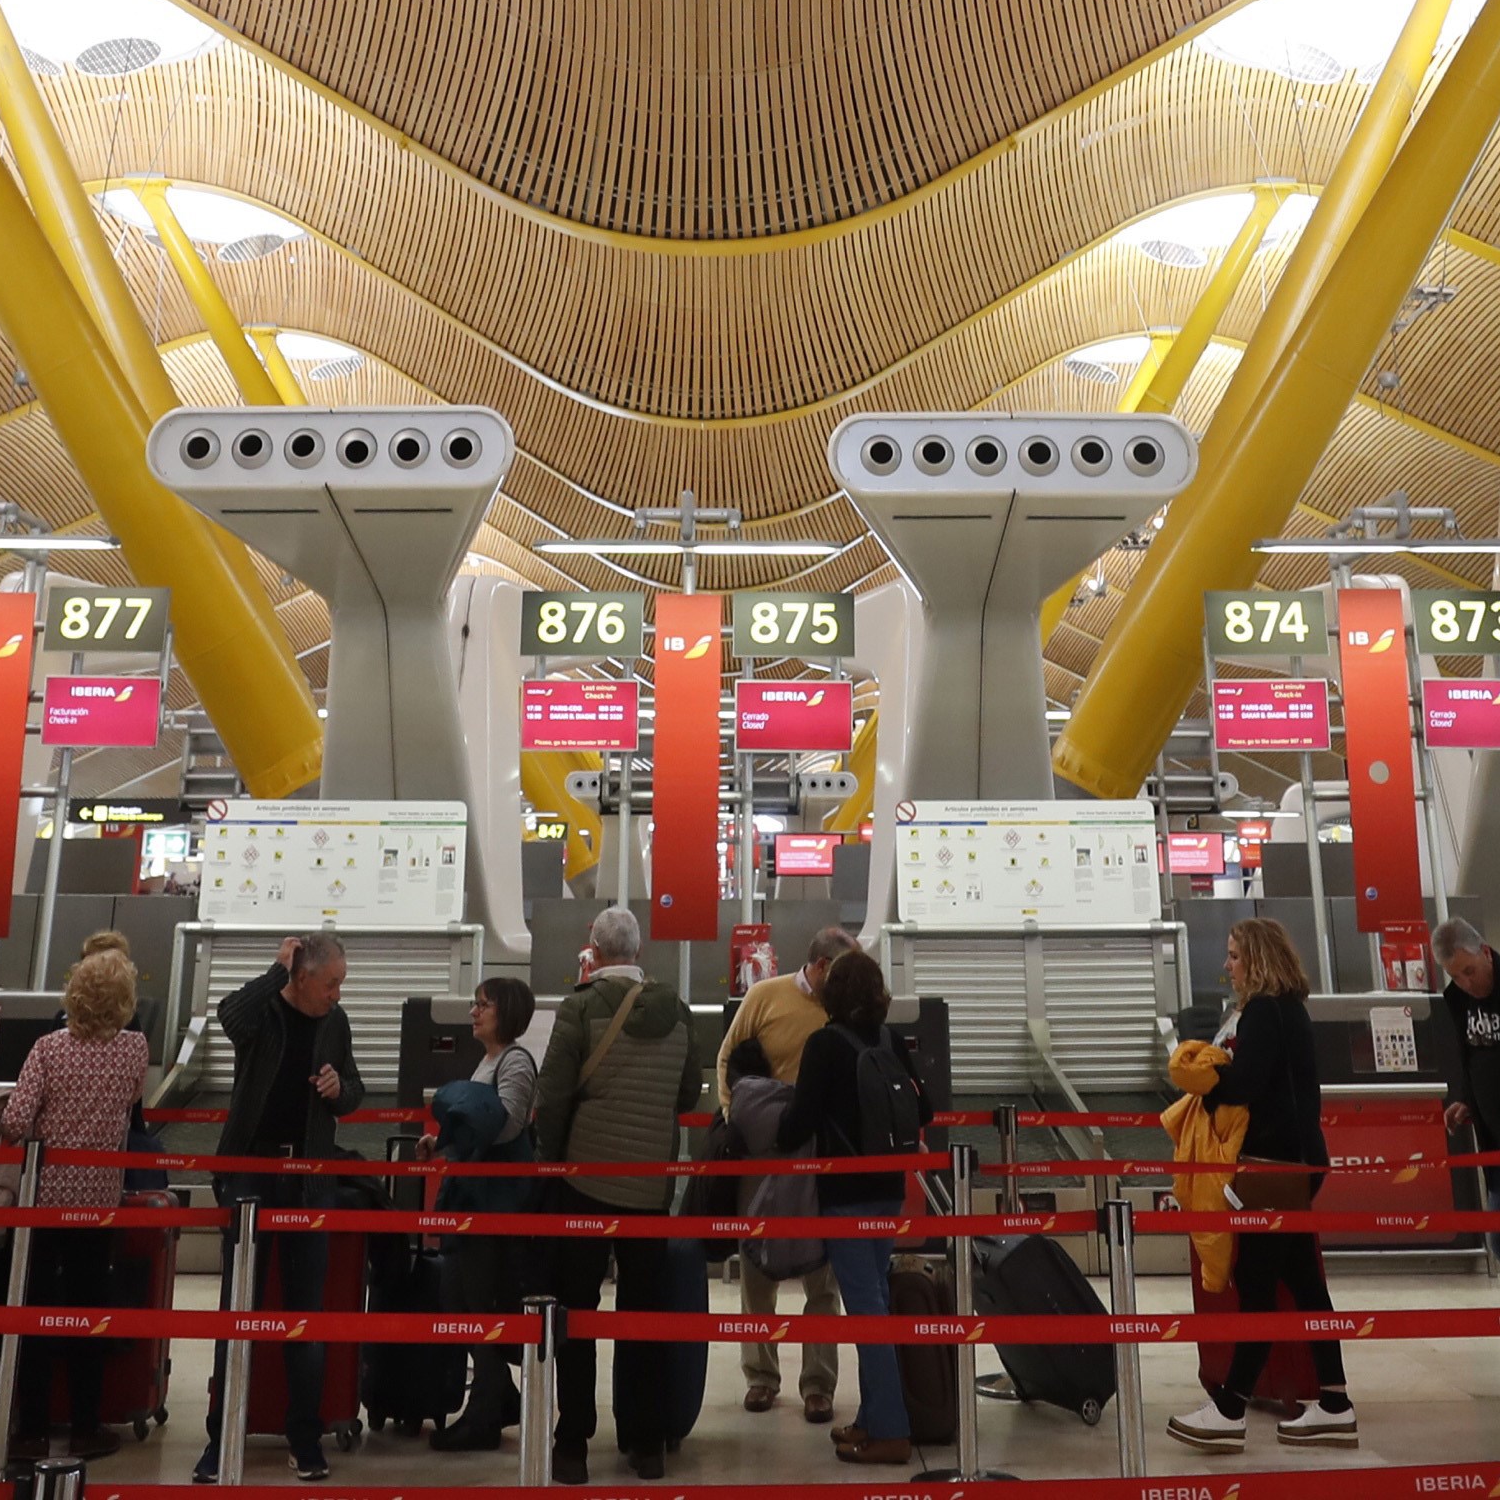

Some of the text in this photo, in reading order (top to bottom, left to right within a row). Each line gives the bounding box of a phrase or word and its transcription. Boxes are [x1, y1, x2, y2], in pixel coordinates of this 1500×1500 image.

[61, 597, 152, 639] 877
[538, 602, 625, 643] 876
[751, 602, 837, 643] 875
[1225, 601, 1308, 642] 874
[665, 637, 684, 650] IB
[1349, 632, 1368, 645] IB
[71, 686, 116, 697] IBERIA
[762, 691, 807, 702] IBERIA
[1448, 689, 1493, 700] IBERIA
[49, 707, 89, 716] Facturación
[742, 712, 769, 721] Cerrado
[1429, 710, 1457, 719] Cerrado
[48, 715, 78, 725] Check-in
[742, 721, 765, 730] Closed
[1430, 719, 1453, 728] Closed
[537, 823, 565, 838] 847
[61, 1212, 100, 1222] IBERIA
[271, 1214, 310, 1224] IBERIA
[1003, 1217, 1042, 1227] IBERIA
[1229, 1216, 1268, 1226] IBERIA
[1376, 1216, 1414, 1226] IBERIA
[39, 1316, 90, 1328] IBERIA
[235, 1319, 286, 1332] IBERIA
[432, 1322, 484, 1334] IBERIA
[718, 1322, 769, 1334] IBERIA
[1110, 1322, 1161, 1334] IBERIA
[1304, 1319, 1356, 1331] IBERIA
[914, 1323, 965, 1335] IBERIA
[1415, 1474, 1486, 1492] IBERIA
[1141, 1487, 1213, 1500] IBERIA
